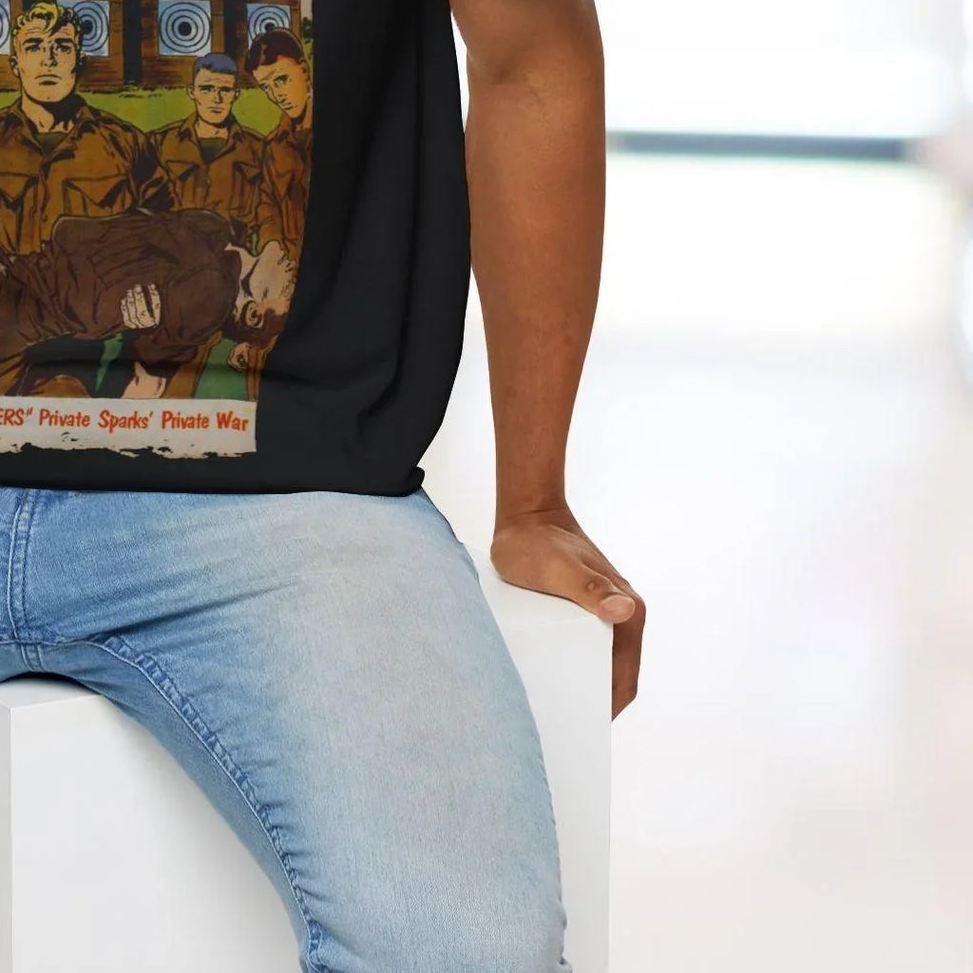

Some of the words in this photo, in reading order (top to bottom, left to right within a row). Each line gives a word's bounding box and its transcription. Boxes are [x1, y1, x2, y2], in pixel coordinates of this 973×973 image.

[38, 408, 90, 427] Private
[97, 409, 154, 433] Sparks'
[161, 410, 210, 429] Private
[216, 410, 249, 432] War
